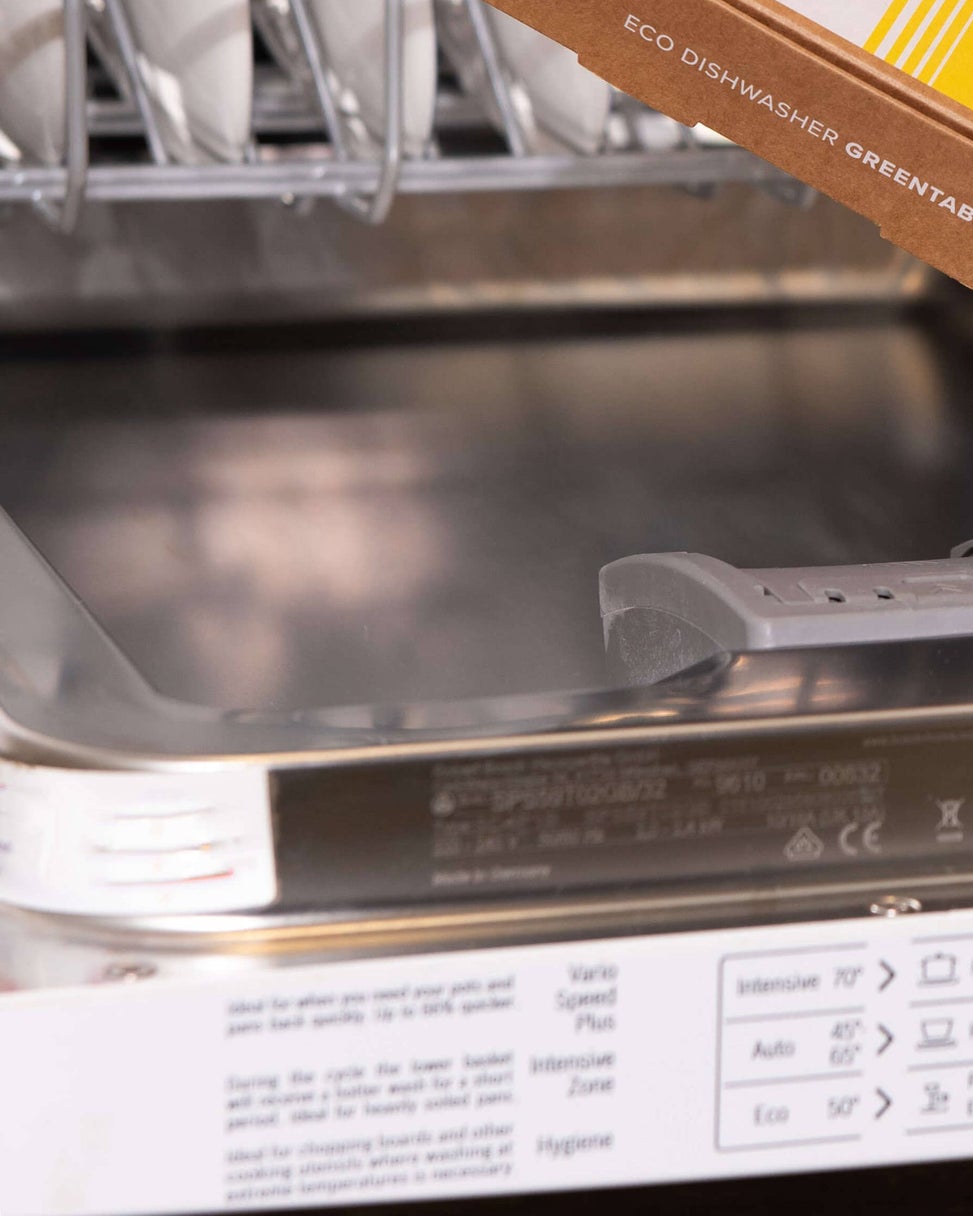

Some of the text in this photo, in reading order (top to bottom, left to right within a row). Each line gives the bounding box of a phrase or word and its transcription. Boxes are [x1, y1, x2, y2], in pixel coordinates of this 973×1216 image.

[624, 13, 675, 52] ECO
[680, 48, 839, 146] DISHWASHER
[753, 1040, 796, 1059] Auto
[754, 1105, 790, 1126] Eco
